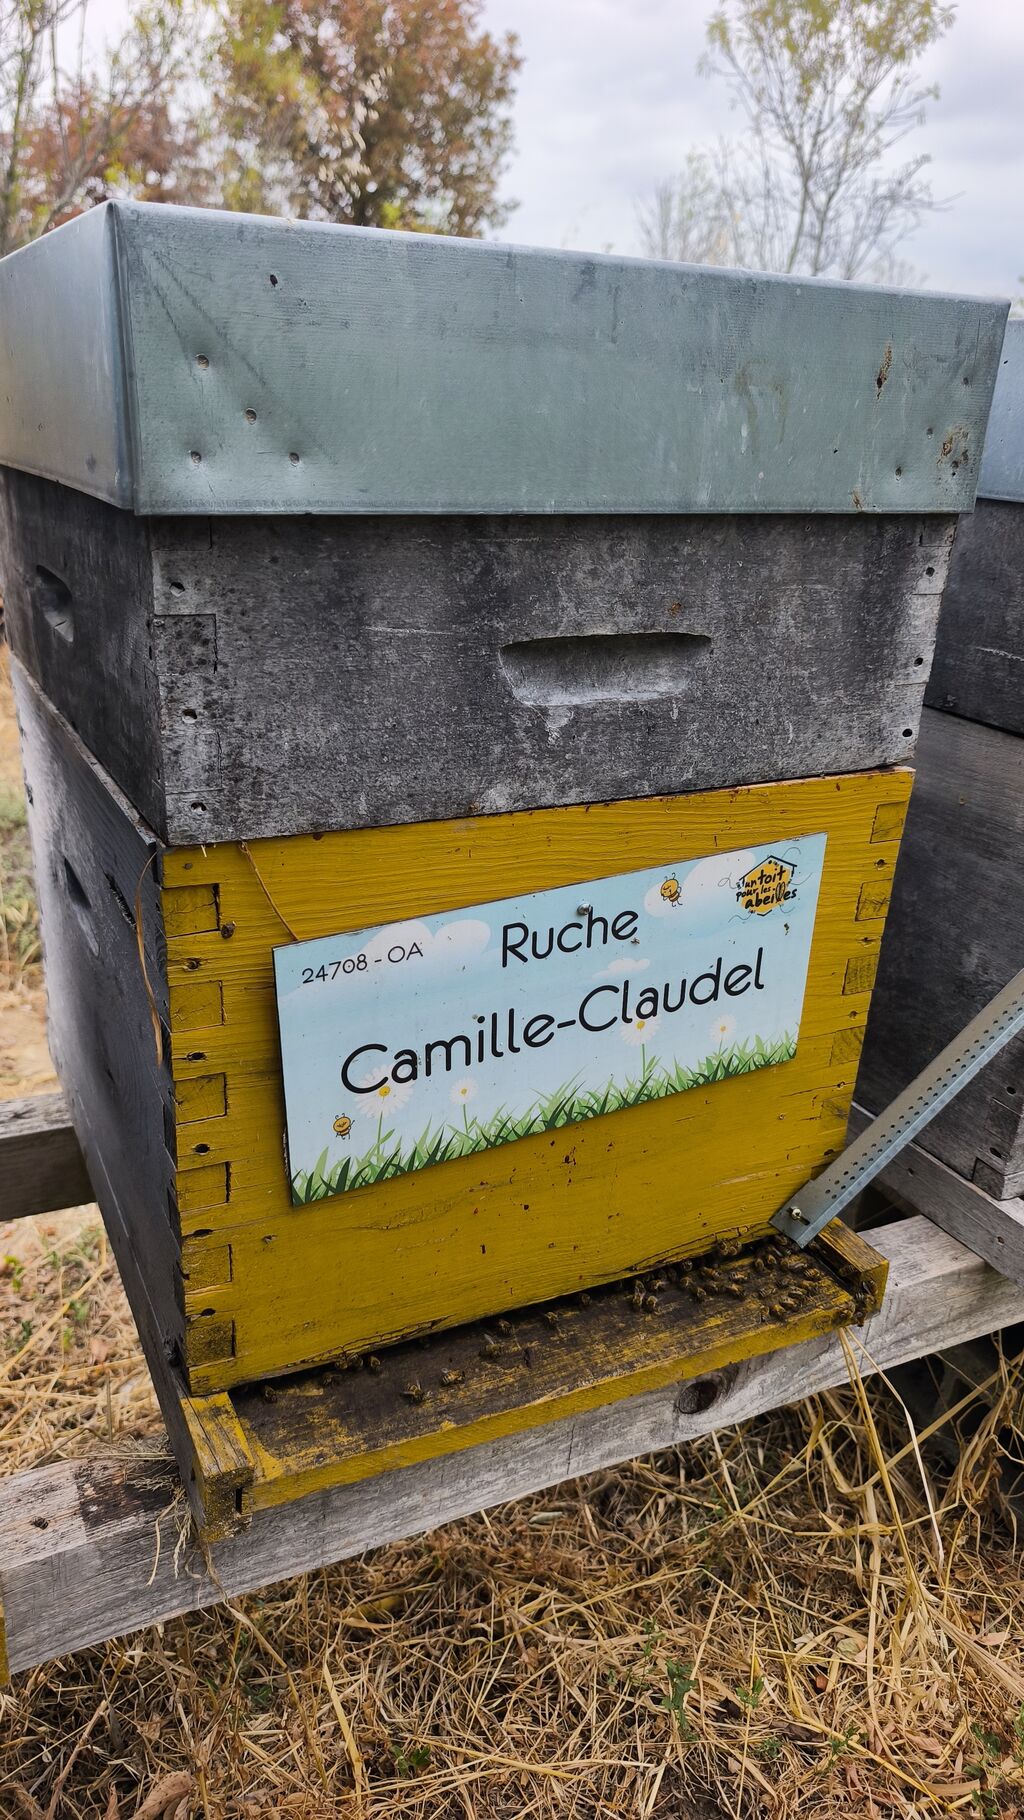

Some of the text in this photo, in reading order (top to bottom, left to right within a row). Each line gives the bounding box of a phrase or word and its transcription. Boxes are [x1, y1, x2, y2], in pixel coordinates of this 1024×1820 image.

[744, 865, 787, 889] un toit
[736, 885, 771, 902] pour les
[744, 881, 798, 909] abeilles
[501, 906, 639, 968] Ruche
[301, 953, 368, 984] 24708
[340, 947, 765, 1095] Camille-Claudel
